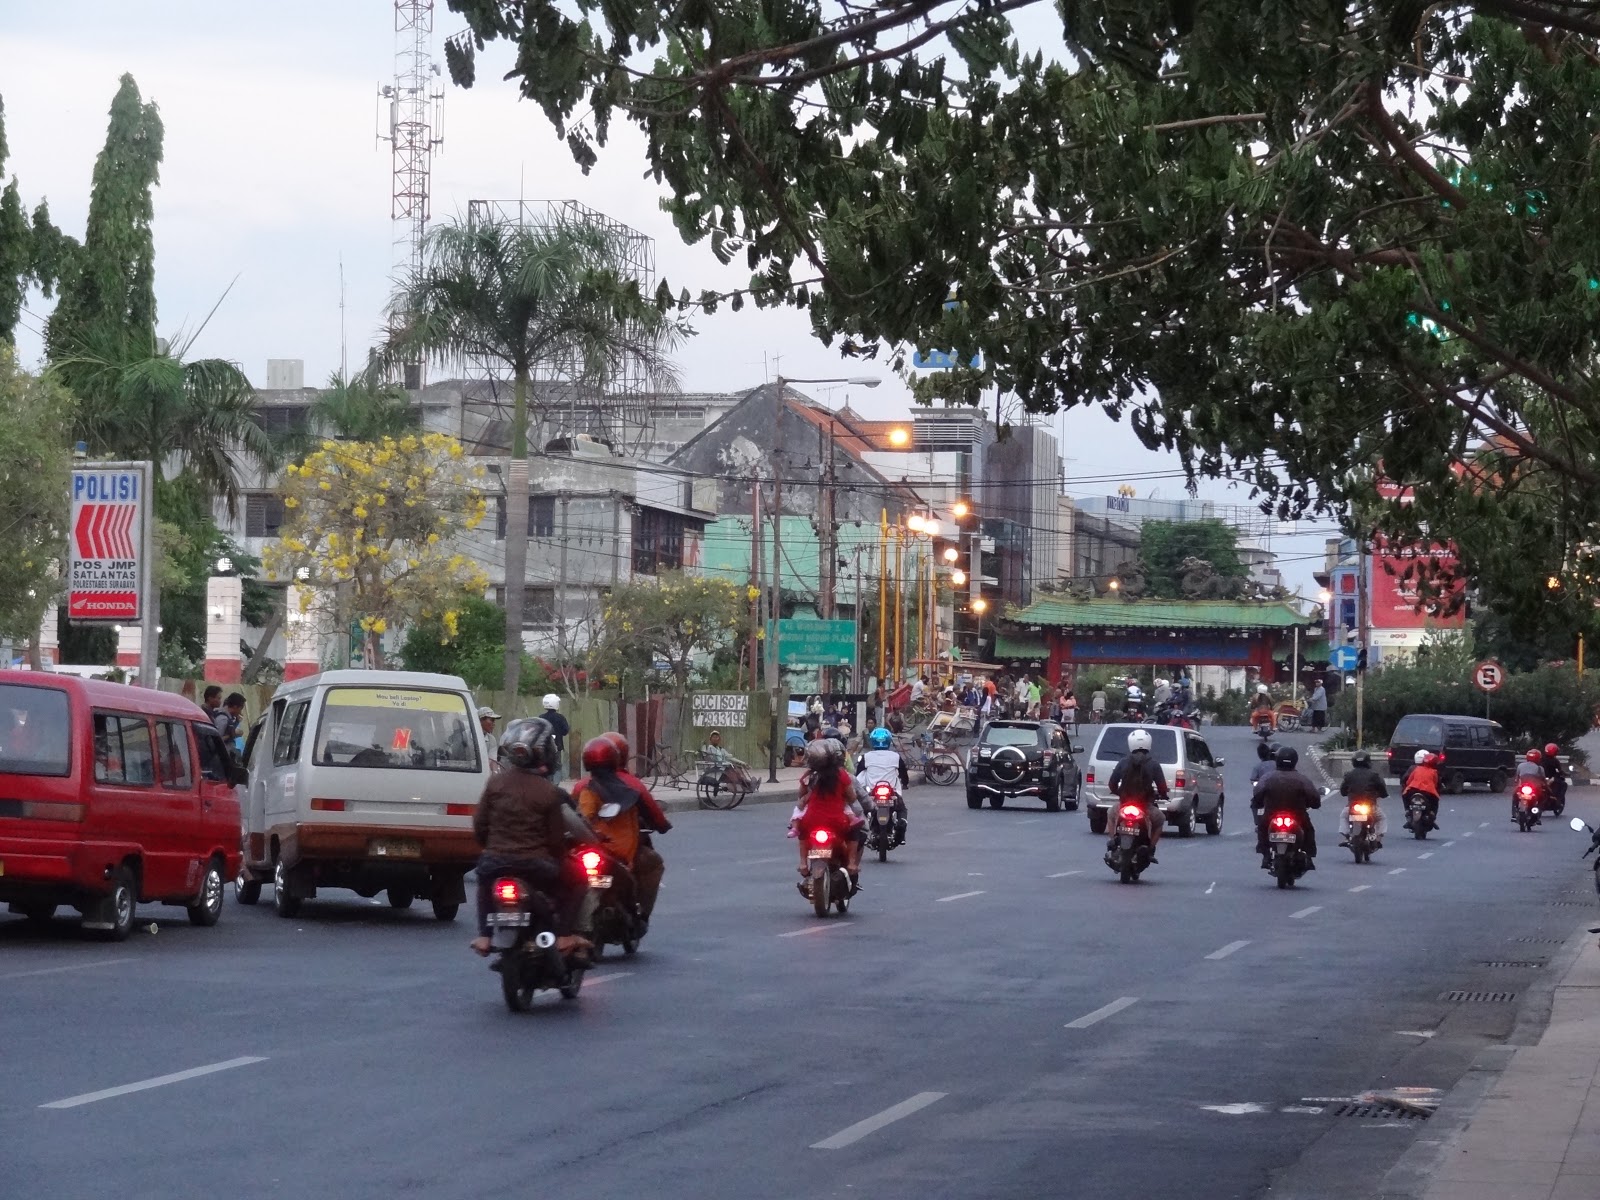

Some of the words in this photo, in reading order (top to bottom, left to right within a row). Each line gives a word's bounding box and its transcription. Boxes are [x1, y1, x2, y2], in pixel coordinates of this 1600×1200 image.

[74, 475, 137, 500] POLISI
[73, 561, 102, 570] POS
[108, 561, 136, 570] JMP
[73, 571, 136, 580] SATLANTAS
[73, 580, 108, 589] POLRESTABES
[109, 580, 136, 589] SURABAYA
[86, 602, 136, 610] HONDA
[1483, 668, 1495, 685] S
[401, 694, 422, 702] Laptop?
[693, 695, 719, 709] CUCI
[721, 695, 748, 709] SOFA
[392, 728, 412, 751] N
